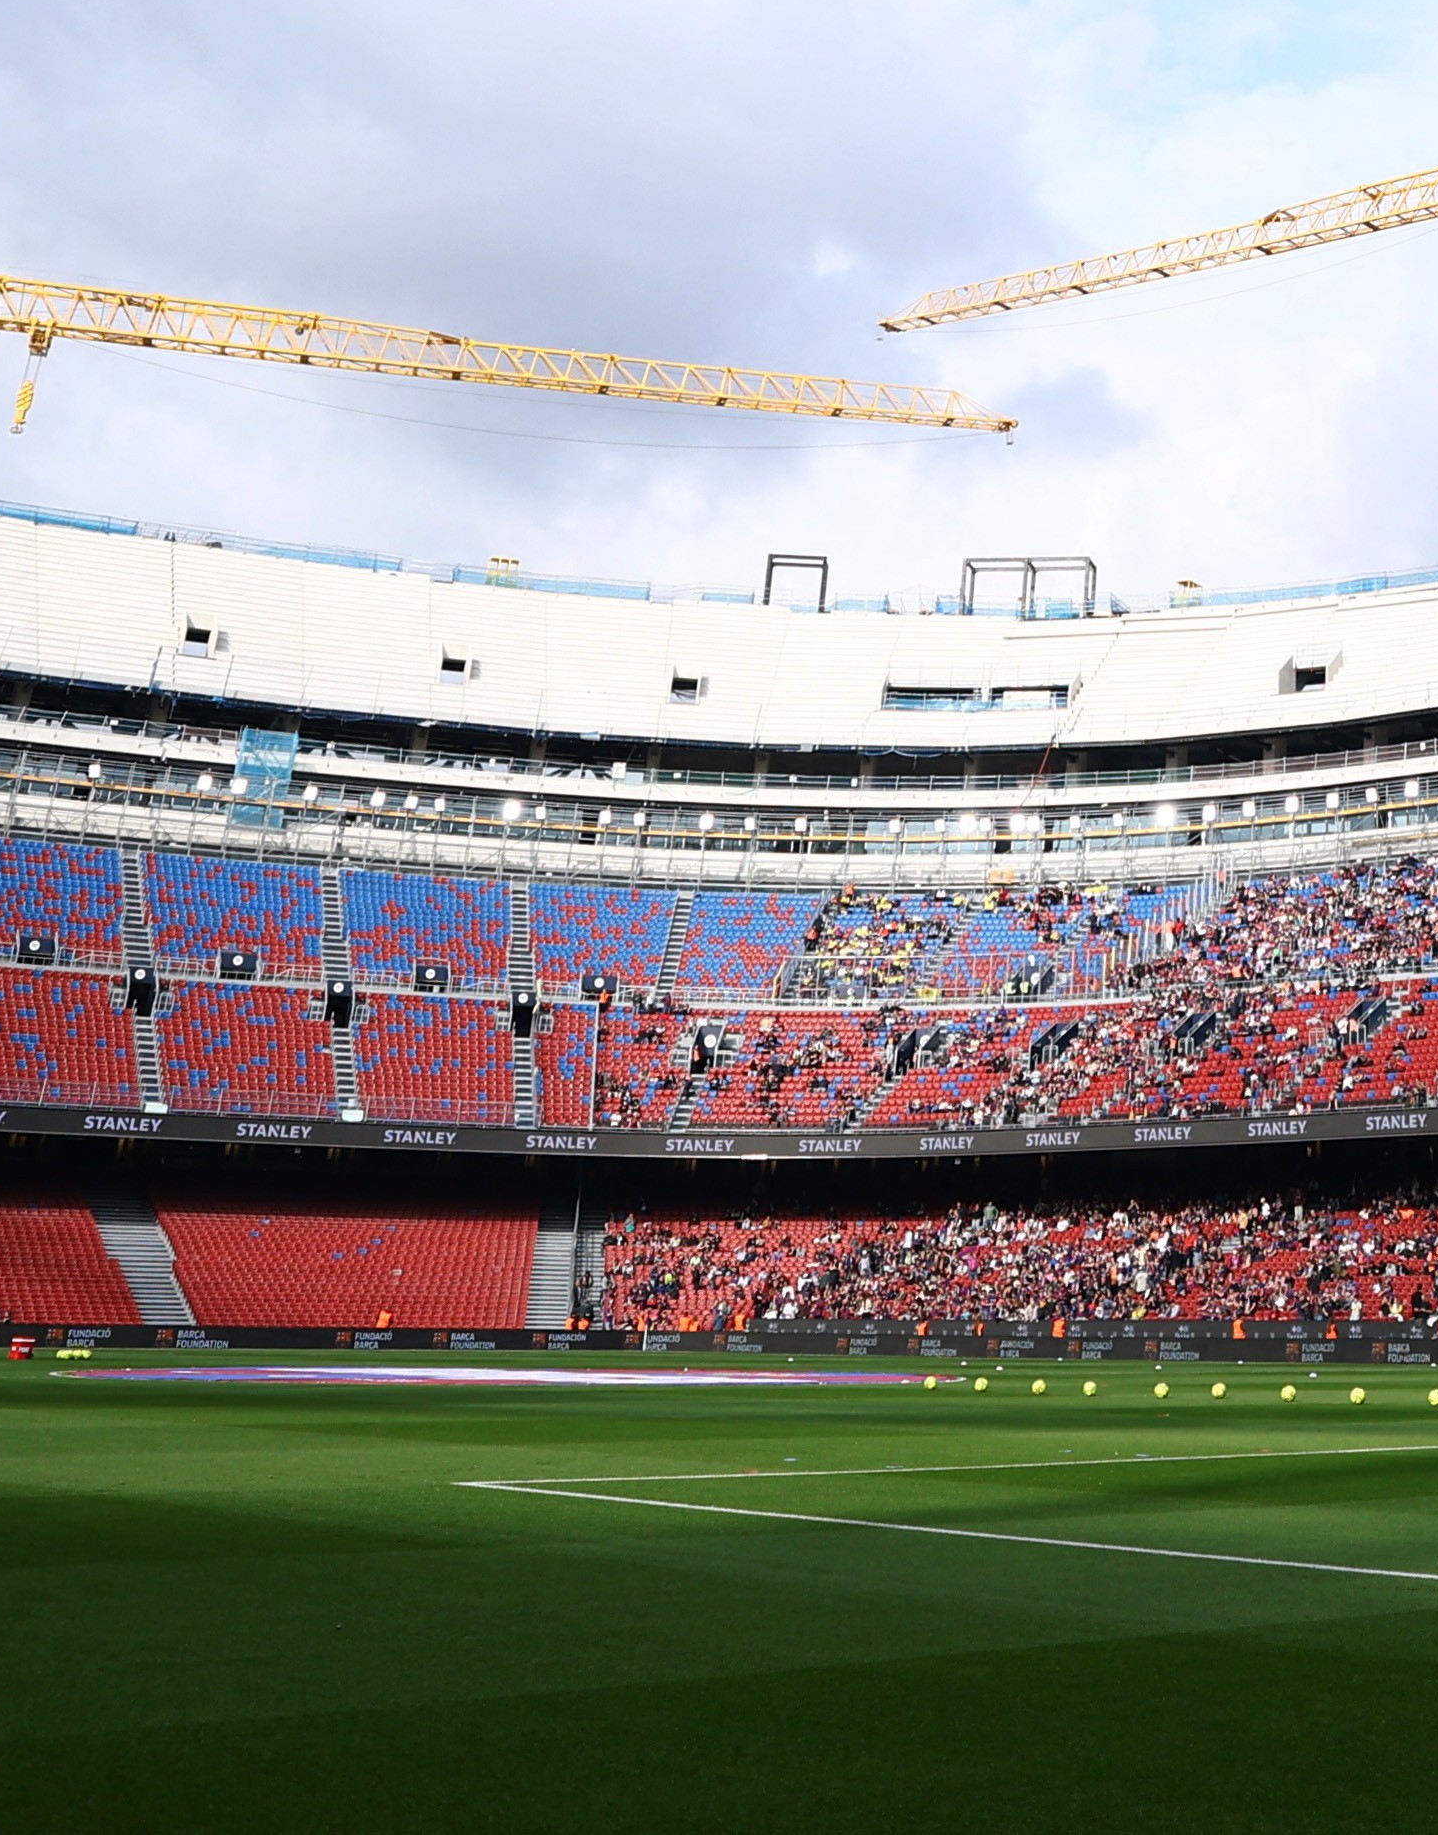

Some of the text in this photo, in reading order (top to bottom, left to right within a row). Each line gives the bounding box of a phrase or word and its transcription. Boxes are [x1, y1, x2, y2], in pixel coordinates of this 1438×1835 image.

[83, 1115, 162, 1133] STANLEY
[1248, 1120, 1308, 1137] STANLEY
[1366, 1113, 1428, 1131] STANLEY
[236, 1122, 312, 1140] STANLEY
[383, 1129, 458, 1146] STANLEY
[1134, 1126, 1192, 1143] STANLEY
[525, 1135, 597, 1151] STANLEY
[665, 1138, 734, 1153] STANLEY
[798, 1138, 862, 1153] STANLEY
[919, 1135, 975, 1151] STANLEY
[1025, 1131, 1081, 1147] STANLEY
[68, 1326, 111, 1338] FUNDACIÓ
[177, 1329, 206, 1340] BARÇA
[355, 1330, 393, 1341] FUNDACIÓ
[450, 1332, 476, 1343] BARÇA
[66, 1338, 96, 1349] BARÇA
[176, 1339, 230, 1350] FOUNDATION
[449, 1342, 496, 1351] FOUNDATION
[1301, 1341, 1335, 1352] FUNDACIÓ
[1301, 1352, 1324, 1363] BARÇA
